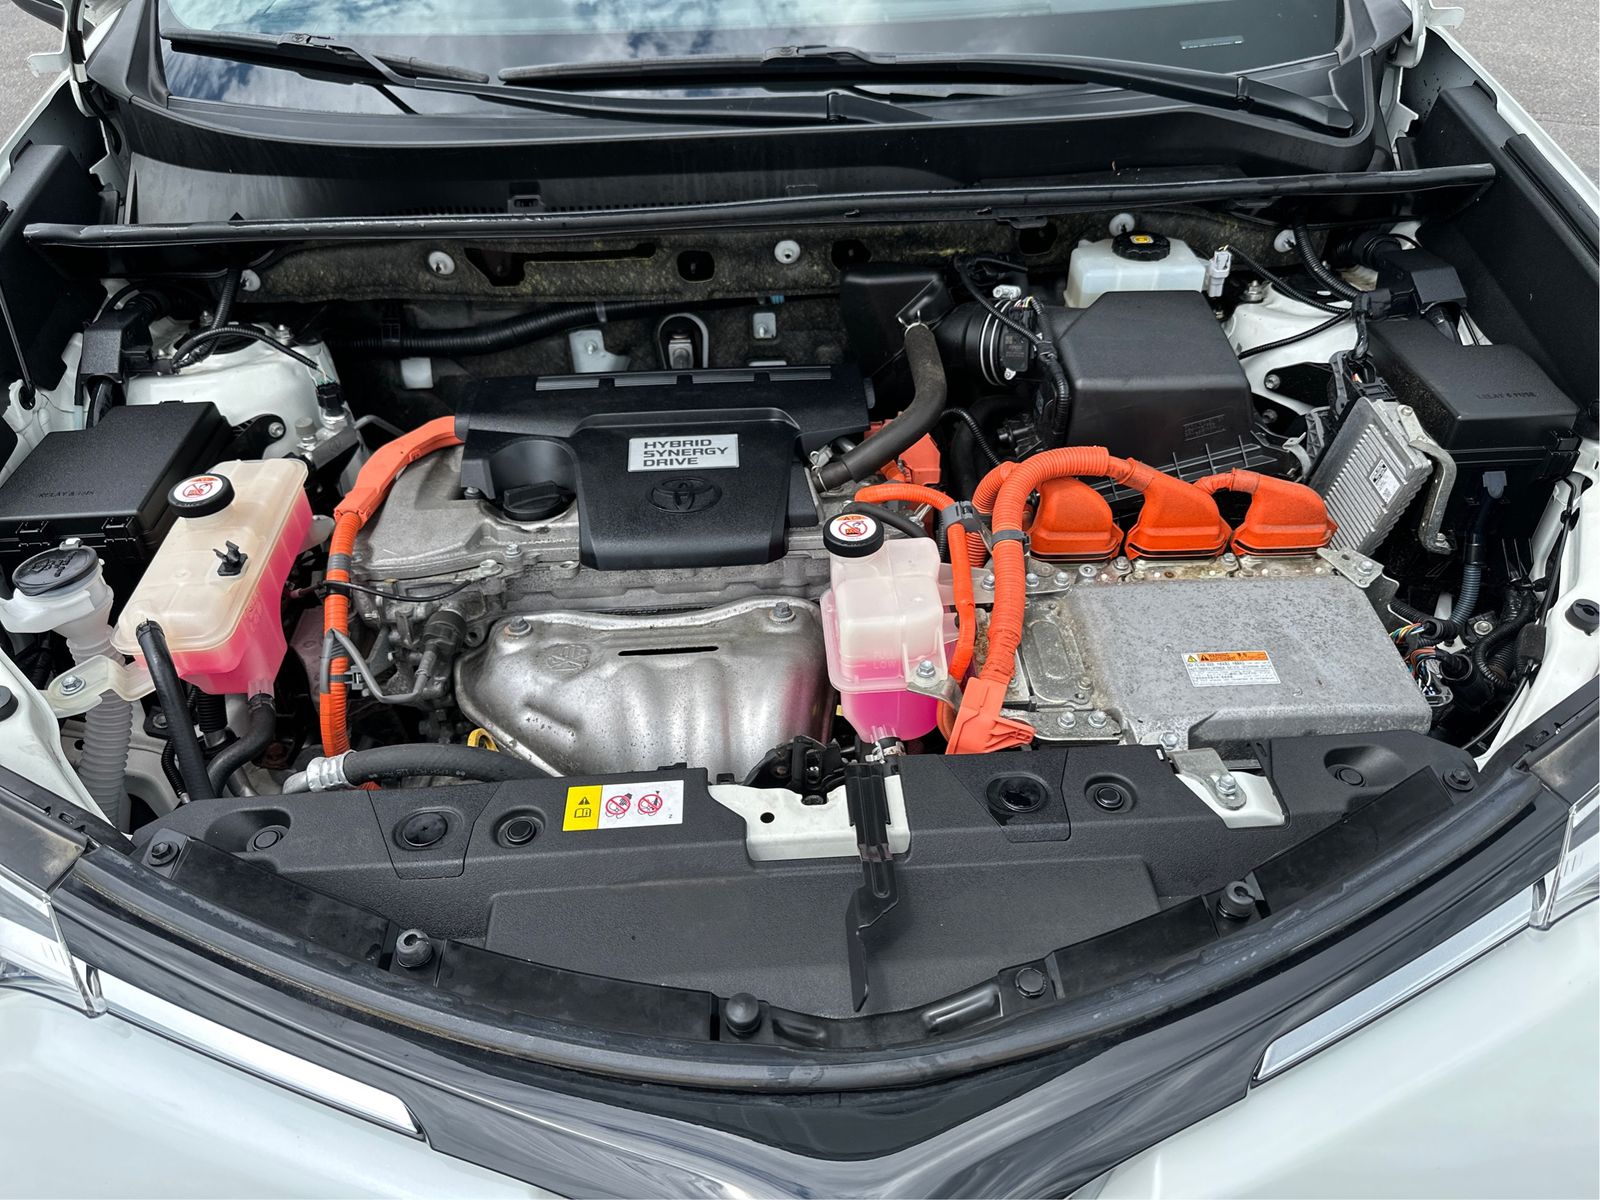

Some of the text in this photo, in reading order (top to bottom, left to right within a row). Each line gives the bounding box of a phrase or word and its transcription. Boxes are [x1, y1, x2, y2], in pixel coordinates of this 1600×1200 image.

[644, 439, 712, 449] HYBRID
[643, 447, 729, 458] SYNERGY
[643, 457, 699, 467] DRIVE
[872, 660, 897, 670] LOW
